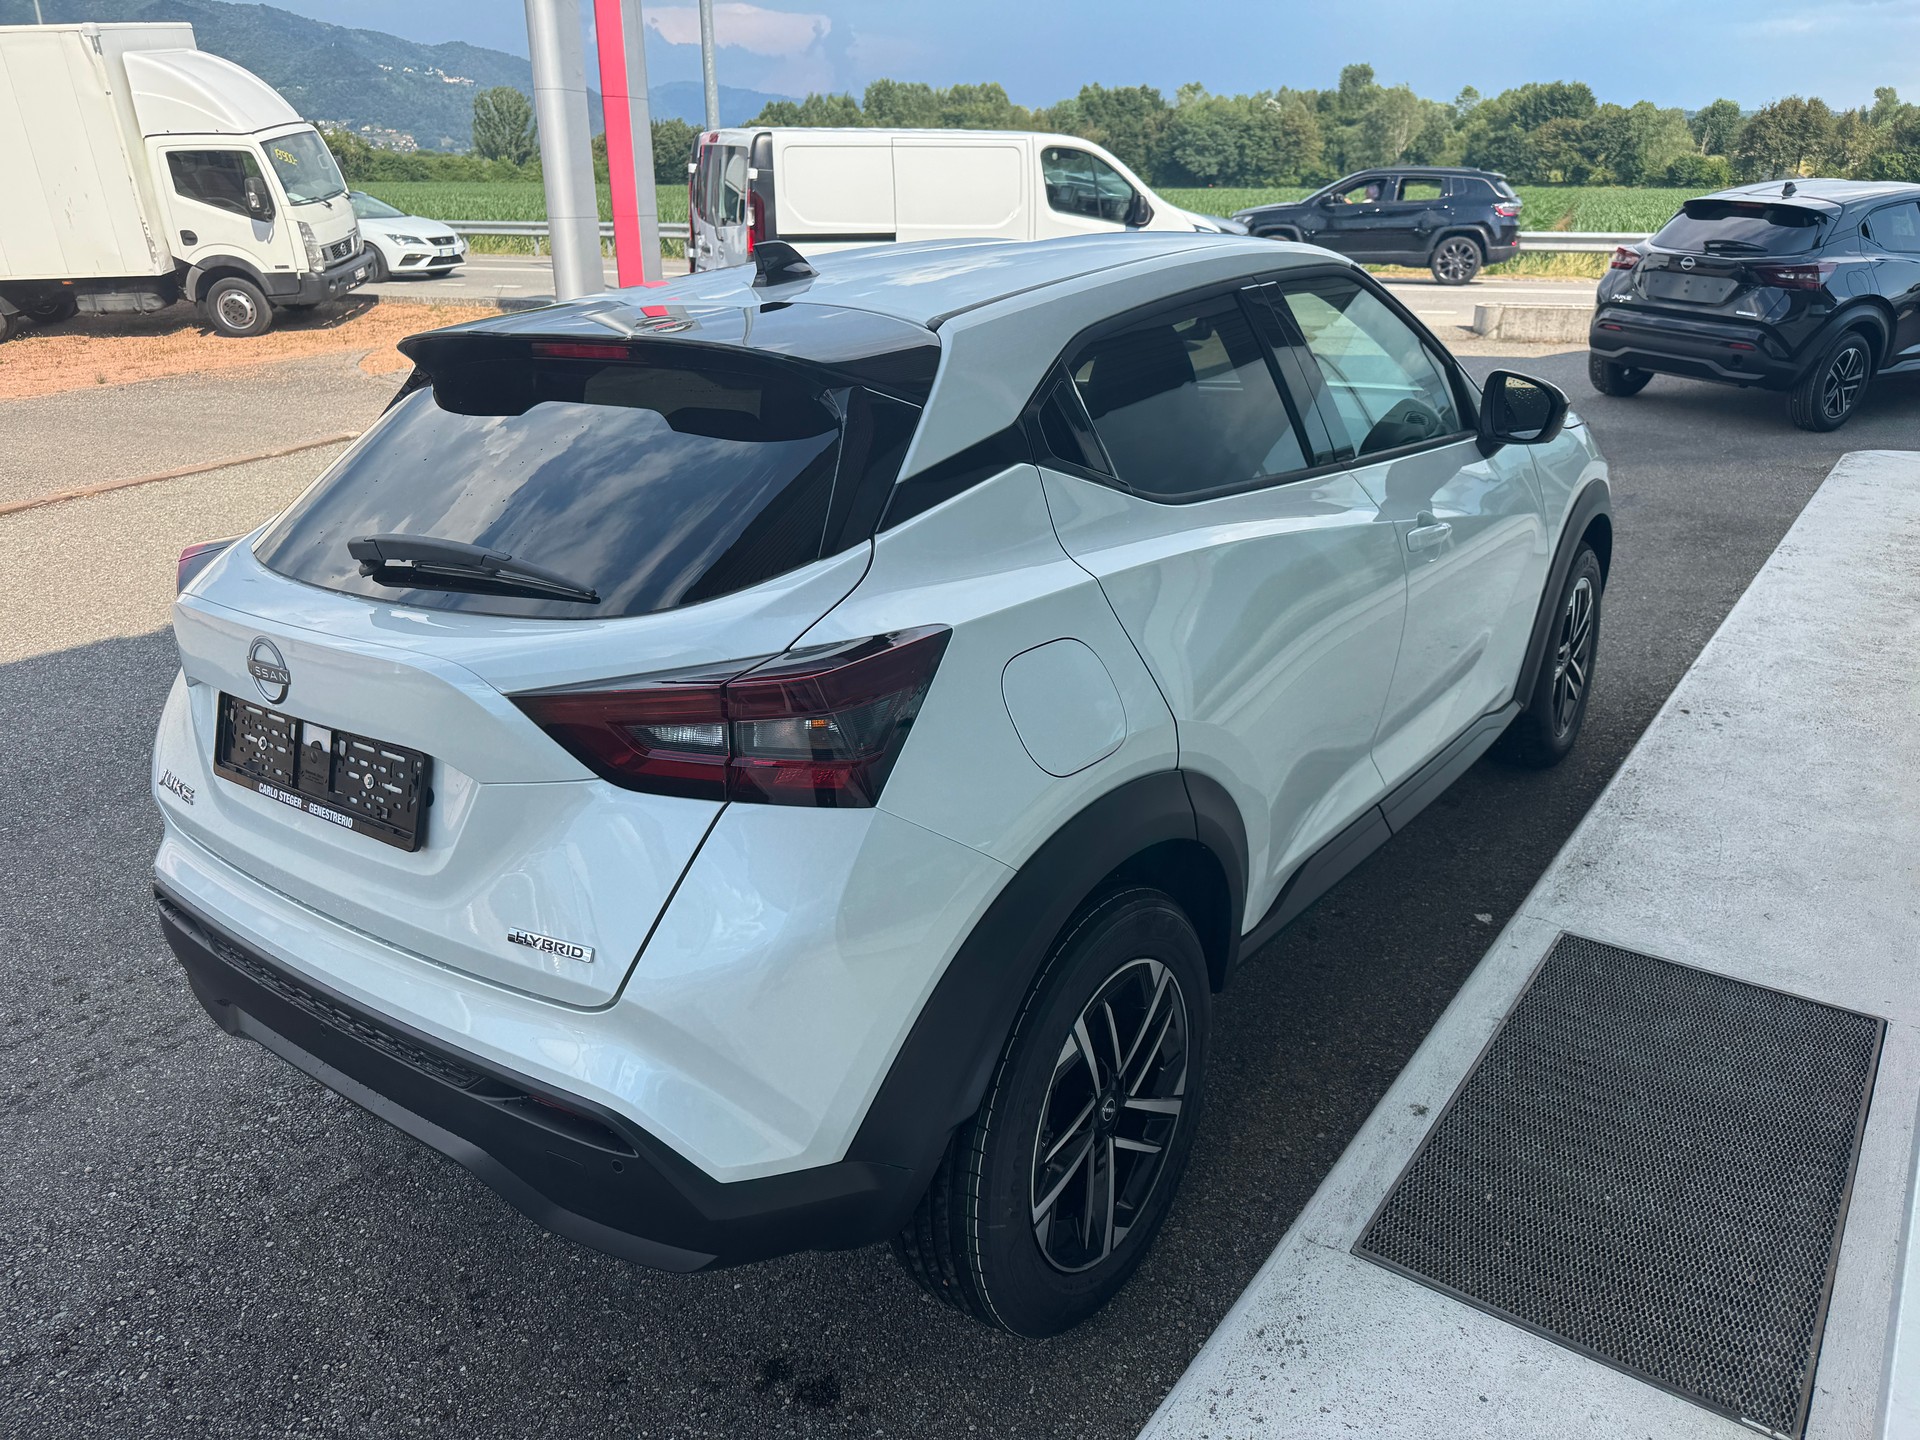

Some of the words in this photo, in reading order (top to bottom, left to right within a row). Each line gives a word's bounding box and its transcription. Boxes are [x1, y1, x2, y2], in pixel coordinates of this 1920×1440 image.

[158, 769, 195, 806] JUKE
[258, 782, 278, 799] CARLO
[278, 790, 302, 809] STEGER
[308, 802, 353, 828] GENESTRERIO
[515, 931, 584, 958] HYBRID
